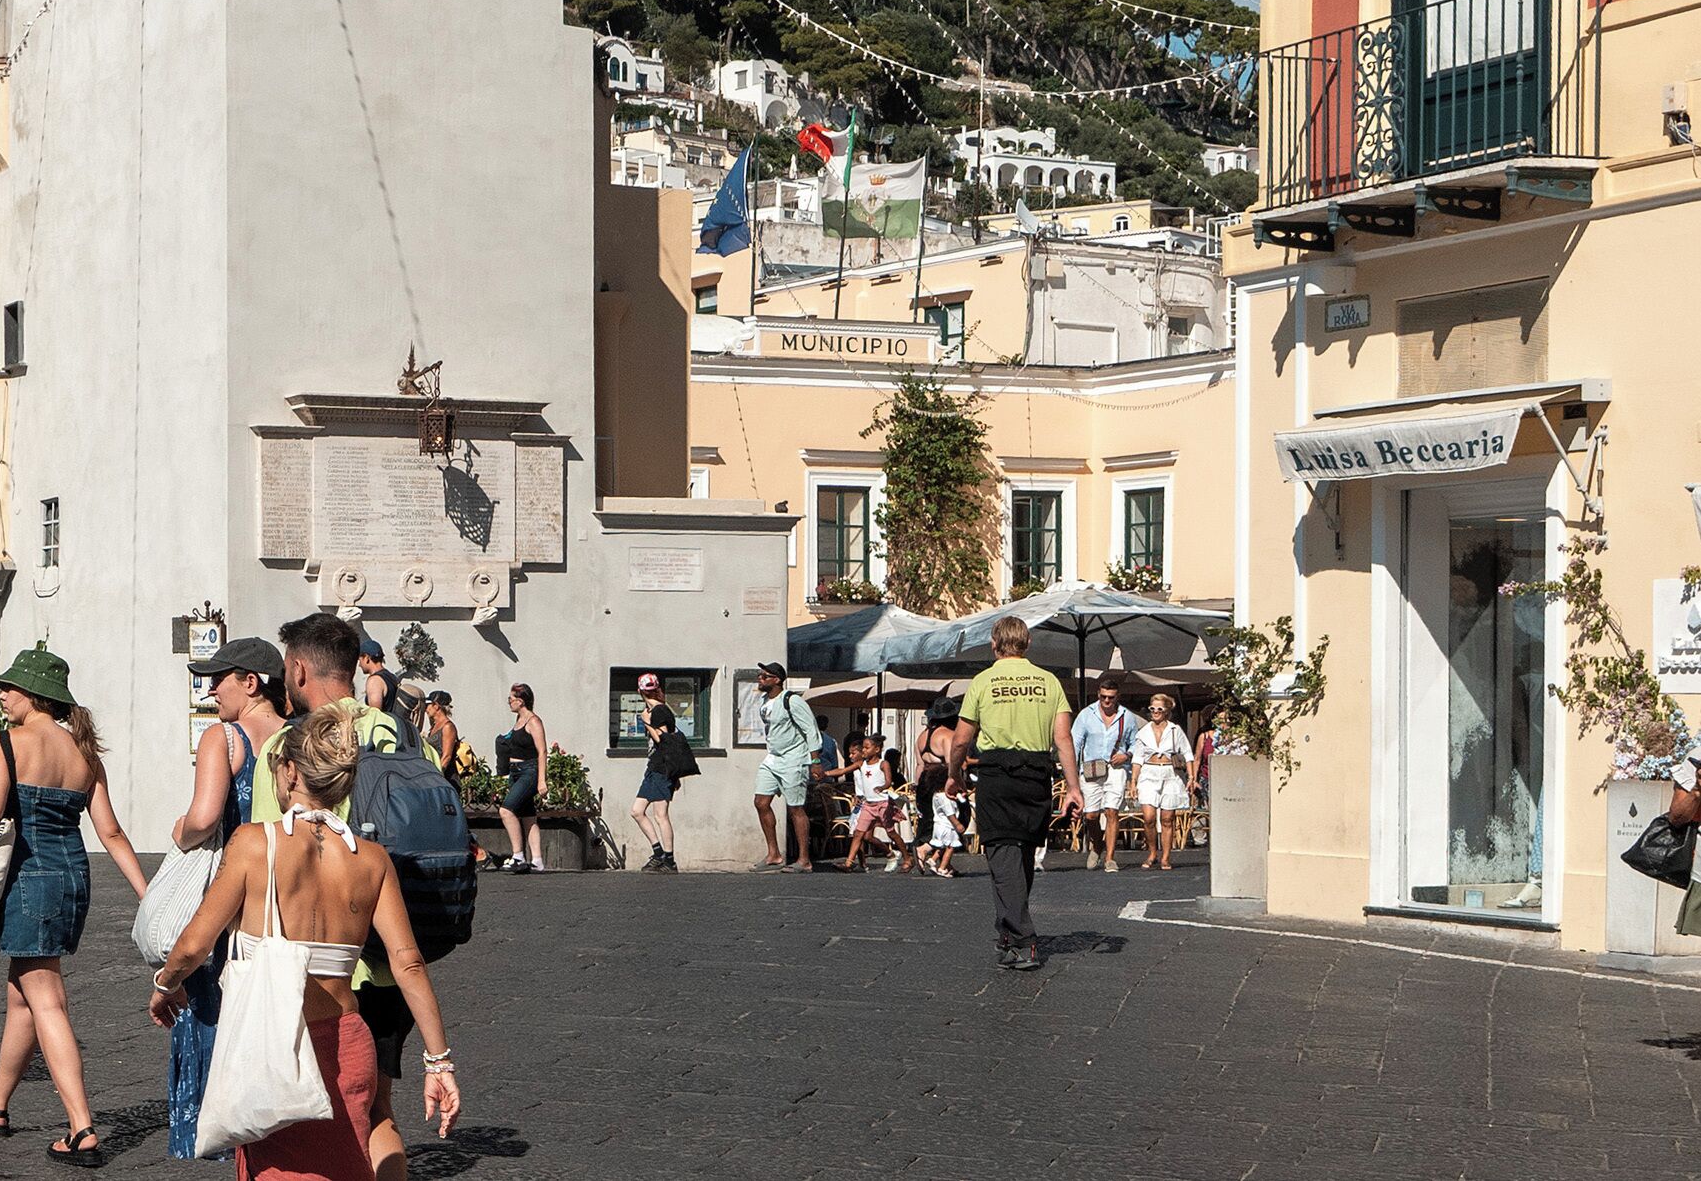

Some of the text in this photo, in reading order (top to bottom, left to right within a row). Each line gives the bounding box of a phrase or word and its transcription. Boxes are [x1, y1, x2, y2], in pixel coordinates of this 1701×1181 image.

[1340, 304, 1356, 315] VIA
[1334, 313, 1361, 326] ROMA
[781, 334, 908, 356] MUNICIPIO
[1287, 430, 1506, 472] Luisa Beccaria
[991, 686, 1047, 698] SEGUICI
[1622, 821, 1644, 829] Luisa
